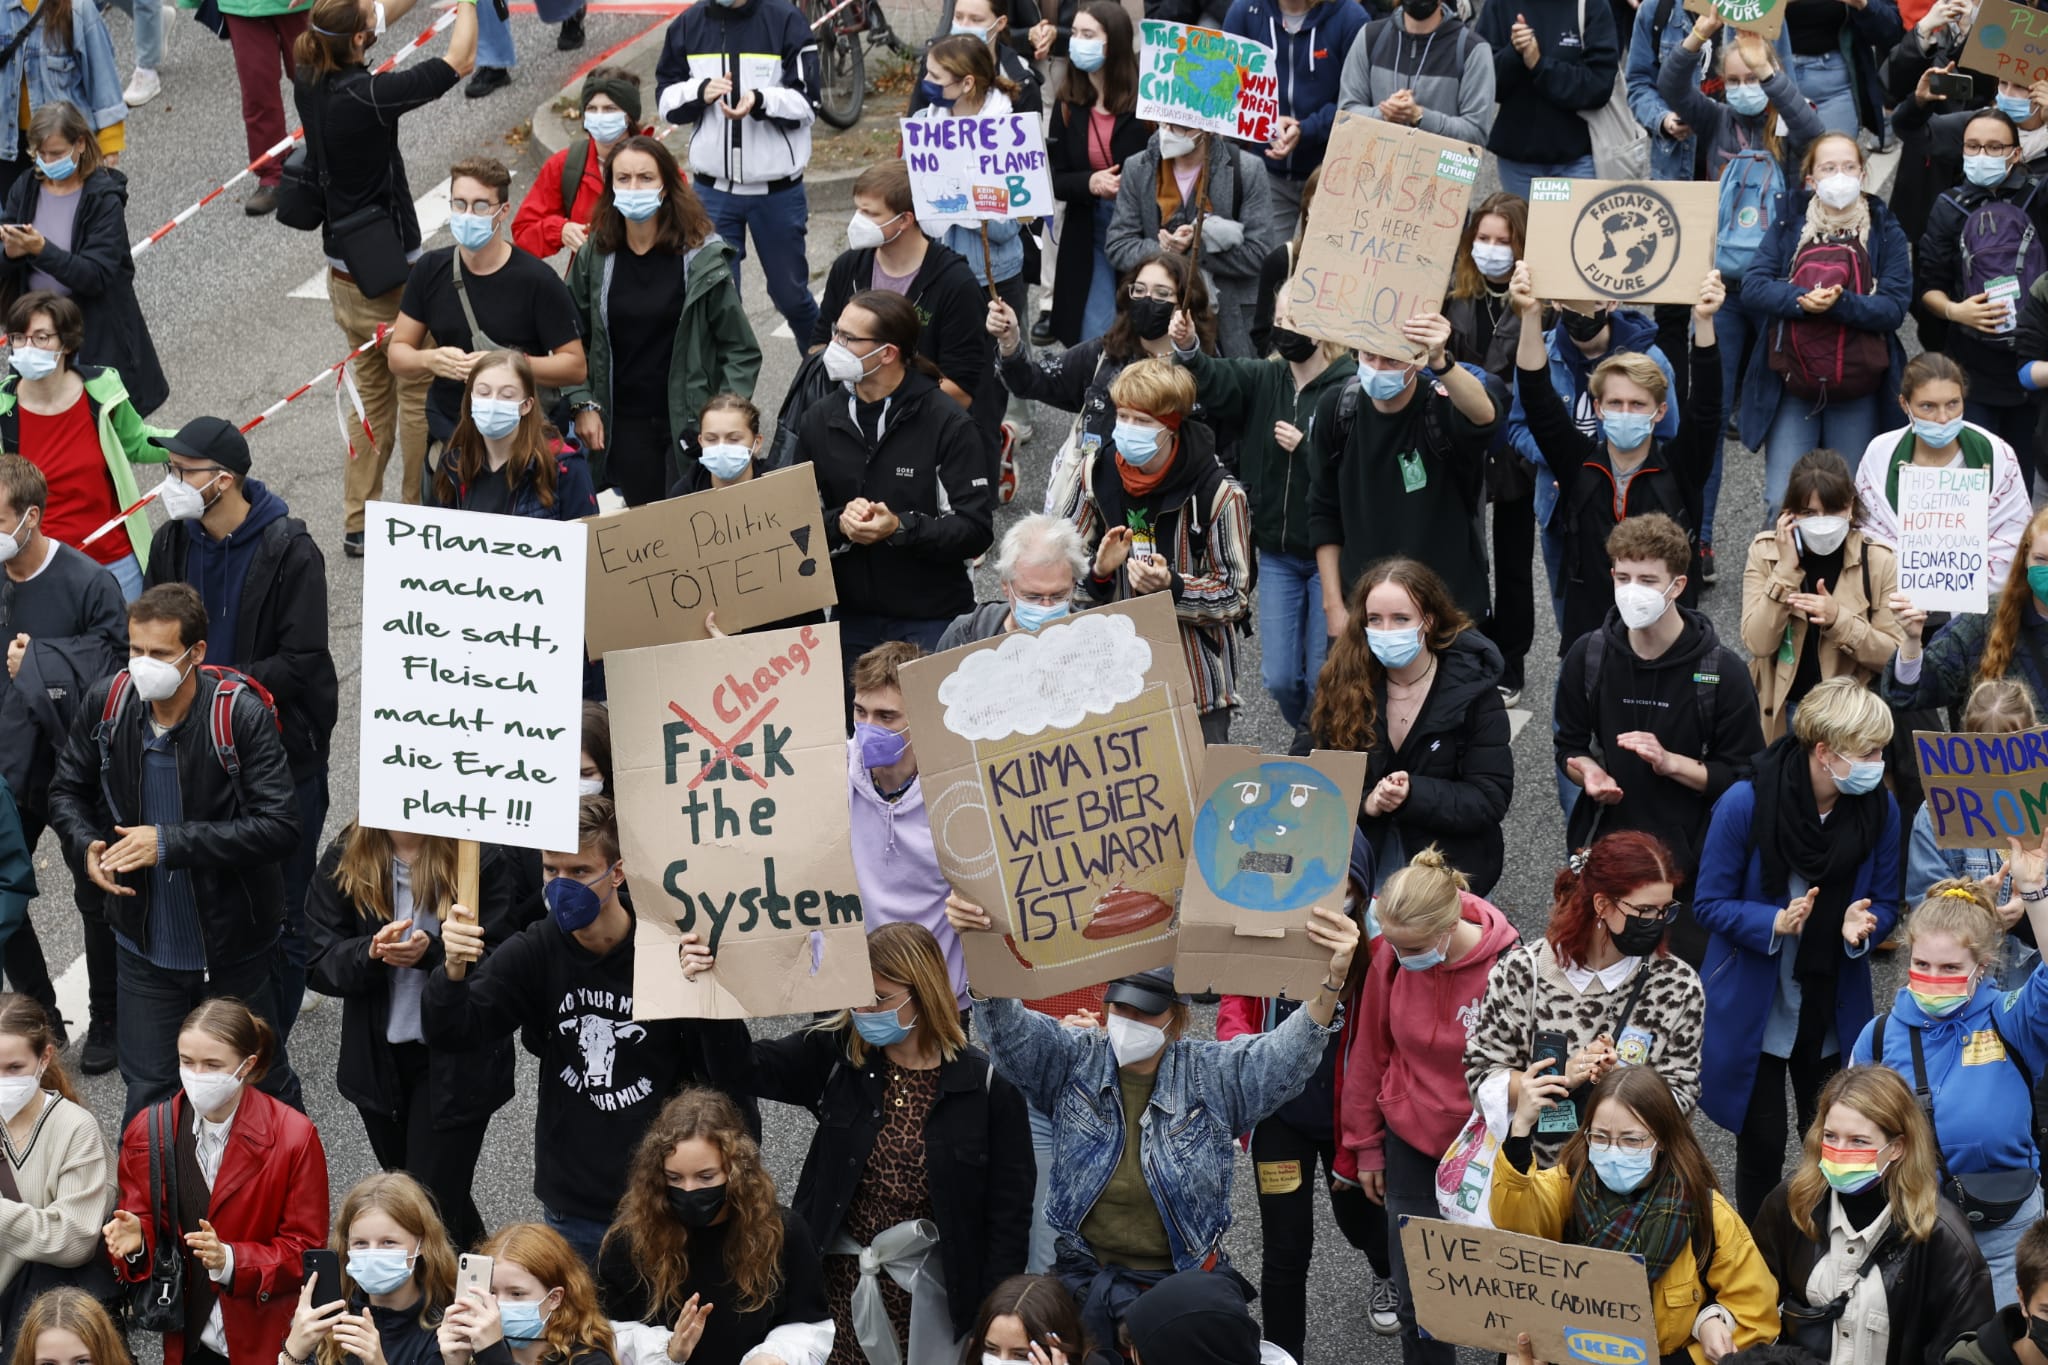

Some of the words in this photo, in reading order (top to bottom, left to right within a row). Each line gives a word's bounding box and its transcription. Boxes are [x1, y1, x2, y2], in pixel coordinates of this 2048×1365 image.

[1140, 22, 1179, 49] THE
[1186, 30, 1267, 73] CLIMATE
[1241, 72, 1276, 97] WHY
[905, 116, 1026, 150] THERE'S
[911, 153, 939, 172] NO
[980, 151, 1045, 174] PLANET
[1377, 136, 1436, 177] THE
[1437, 163, 1476, 181] FUTURE!
[1440, 150, 1479, 168] FRIDAYS
[1005, 175, 1031, 207] B
[1323, 156, 1460, 229] CRISIS
[1532, 192, 1570, 201] RETTEN
[1533, 180, 1570, 191] KLIMA
[1353, 208, 1369, 230] IS
[1381, 216, 1422, 241] HERE
[1589, 194, 1654, 221] FRIDAYS
[1652, 207, 1674, 238] FOR
[1349, 230, 1412, 264] TAKE
[1363, 258, 1385, 277] IT
[1584, 263, 1646, 291] FUTURE
[1902, 470, 1935, 491] THIS
[1939, 470, 1989, 491] PLANET
[1908, 494, 1919, 510] IS
[1921, 493, 1970, 510] GETTING
[1904, 512, 1967, 531] HOTTER
[385, 518, 562, 562] Pflanzen
[596, 524, 668, 573] Eure
[690, 504, 782, 558] Politik
[1901, 534, 1932, 549] THAN
[1938, 534, 1980, 549] YOUNG
[1902, 551, 1982, 571] LEONARDO
[400, 577, 544, 605] machen
[382, 611, 449, 637] alle
[461, 623, 559, 654] satt,
[401, 656, 538, 694] Fleisch
[713, 625, 820, 724] Change
[374, 708, 494, 730] macht
[504, 720, 566, 740] nur
[382, 745, 442, 769] die
[452, 751, 557, 784] Erde
[1094, 726, 1147, 776] IST
[1917, 737, 1975, 775] NO
[403, 790, 496, 820] platt
[681, 788, 776, 845] the
[1000, 798, 1075, 851] WIE
[1010, 846, 1069, 897] ZU
[1071, 813, 1185, 879] WARM
[662, 857, 864, 956] System
[1017, 885, 1086, 942] IST
[577, 987, 615, 1011] YOUR
[615, 1077, 653, 1109] MILK
[1421, 1228, 1480, 1263] I'VE
[1496, 1246, 1590, 1279] SEEN
[1427, 1268, 1545, 1306] SMARTER
[1551, 1290, 1641, 1322] CABINETS
[1484, 1311, 1513, 1329] AT
[1574, 1337, 1640, 1360] IKEA
